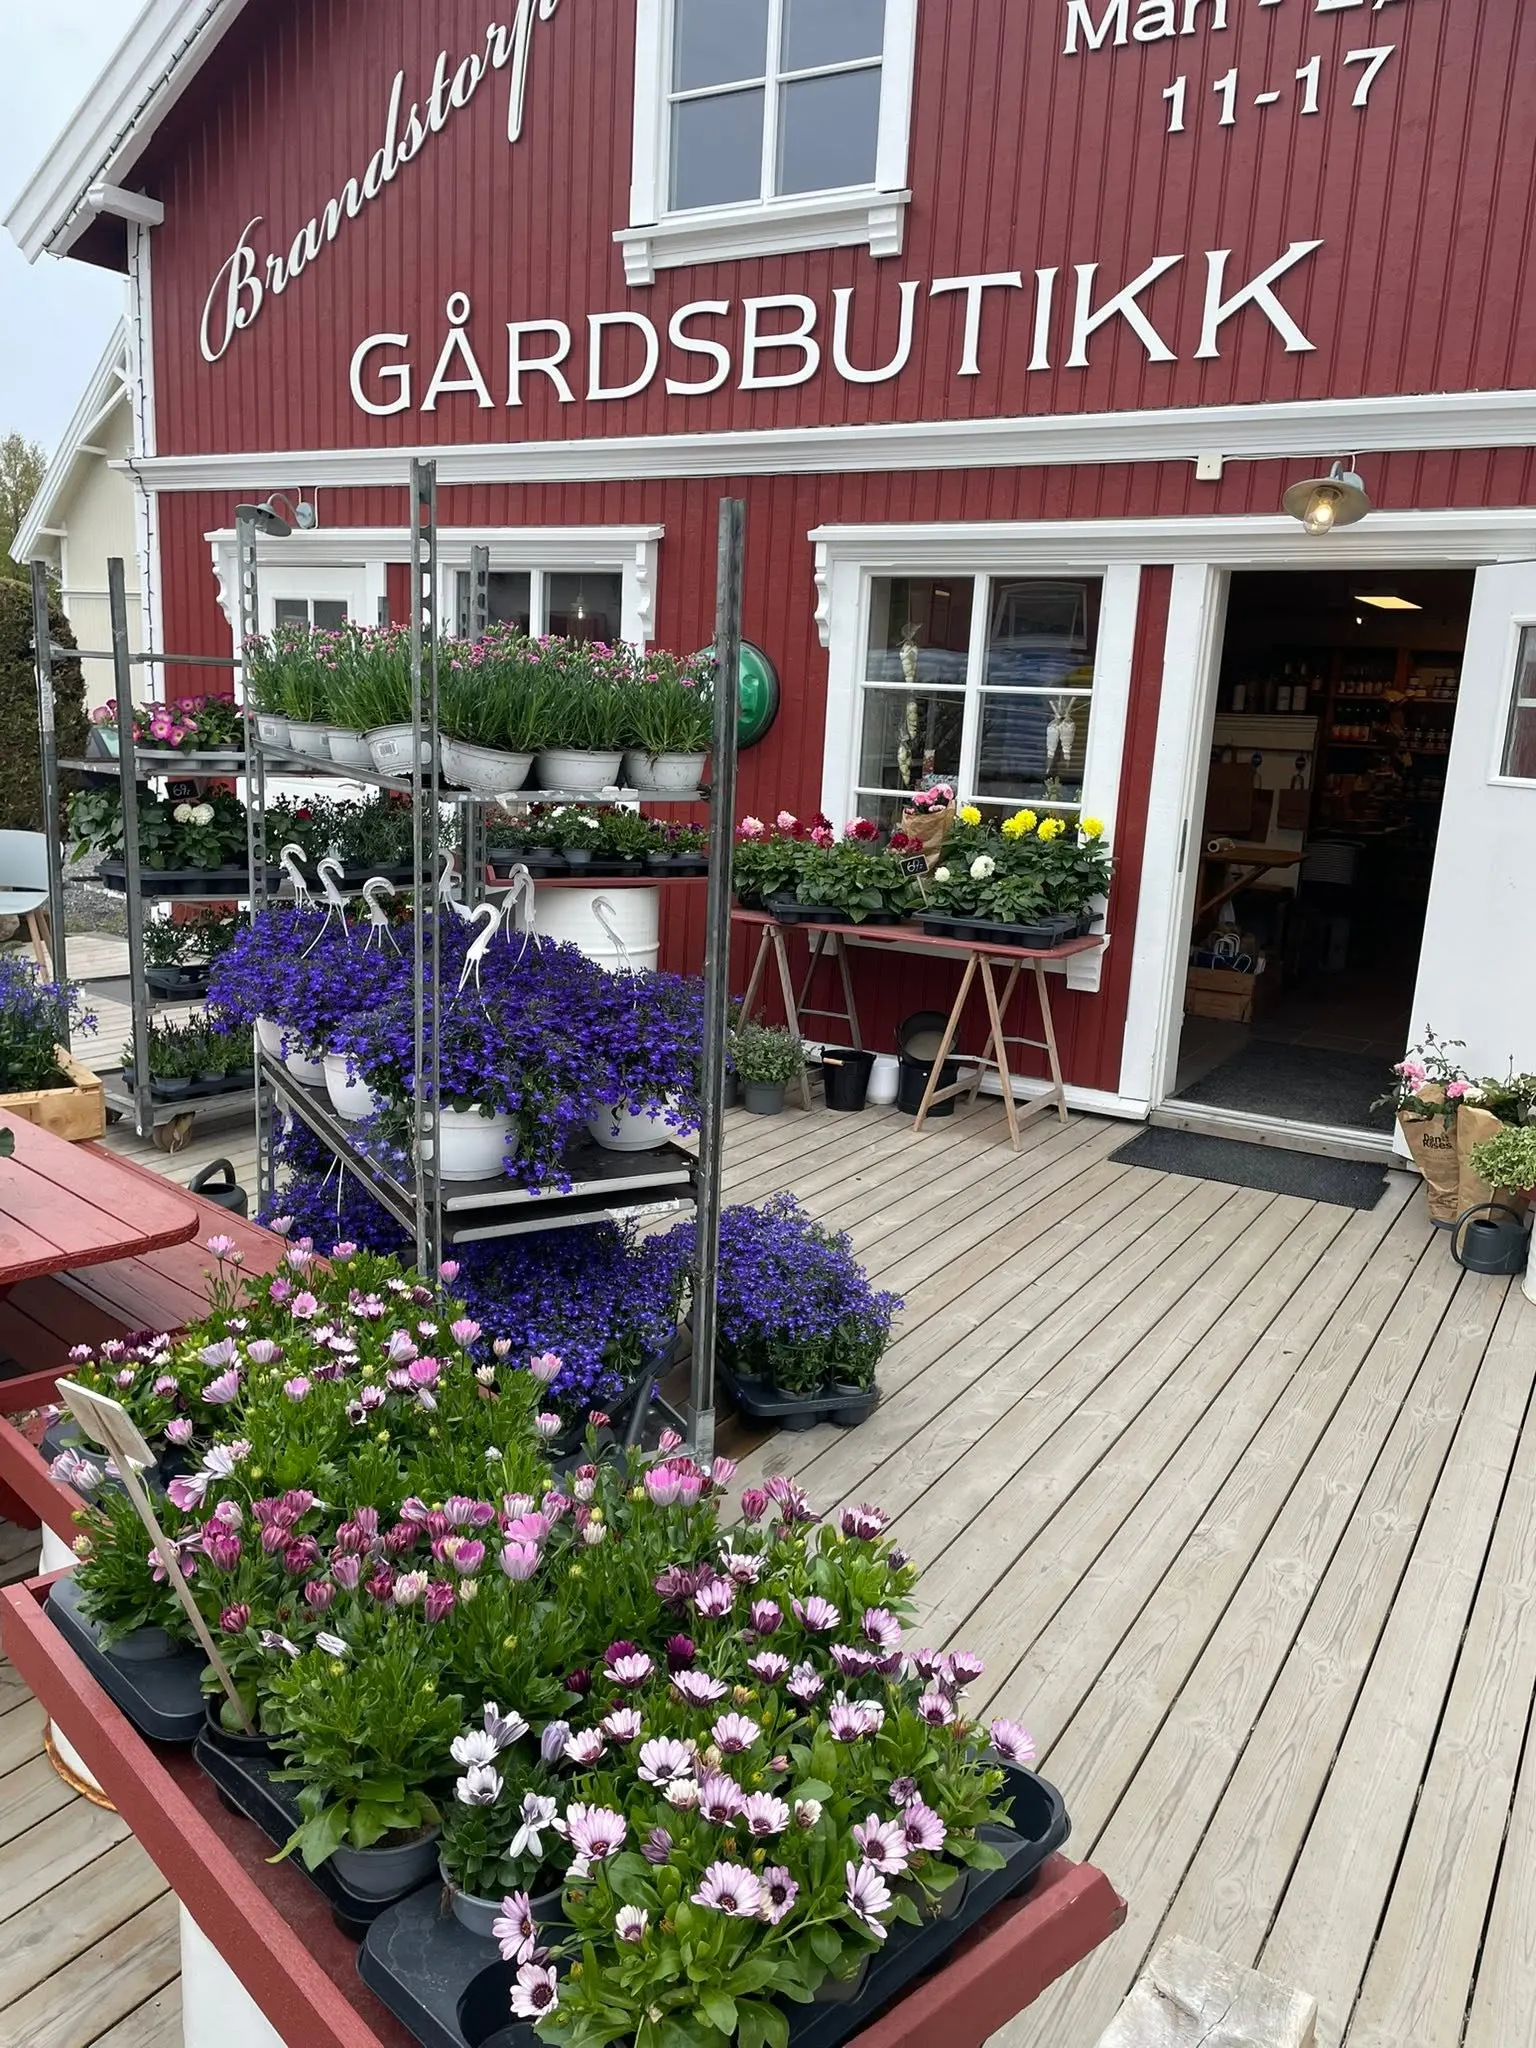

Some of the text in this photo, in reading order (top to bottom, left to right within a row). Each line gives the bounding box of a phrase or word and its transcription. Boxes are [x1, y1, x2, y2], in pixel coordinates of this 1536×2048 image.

[1062, 0, 1228, 55] Man
[1162, 44, 1396, 133] 11-17
[350, 239, 1324, 416] GÅRDSBUTIKK
